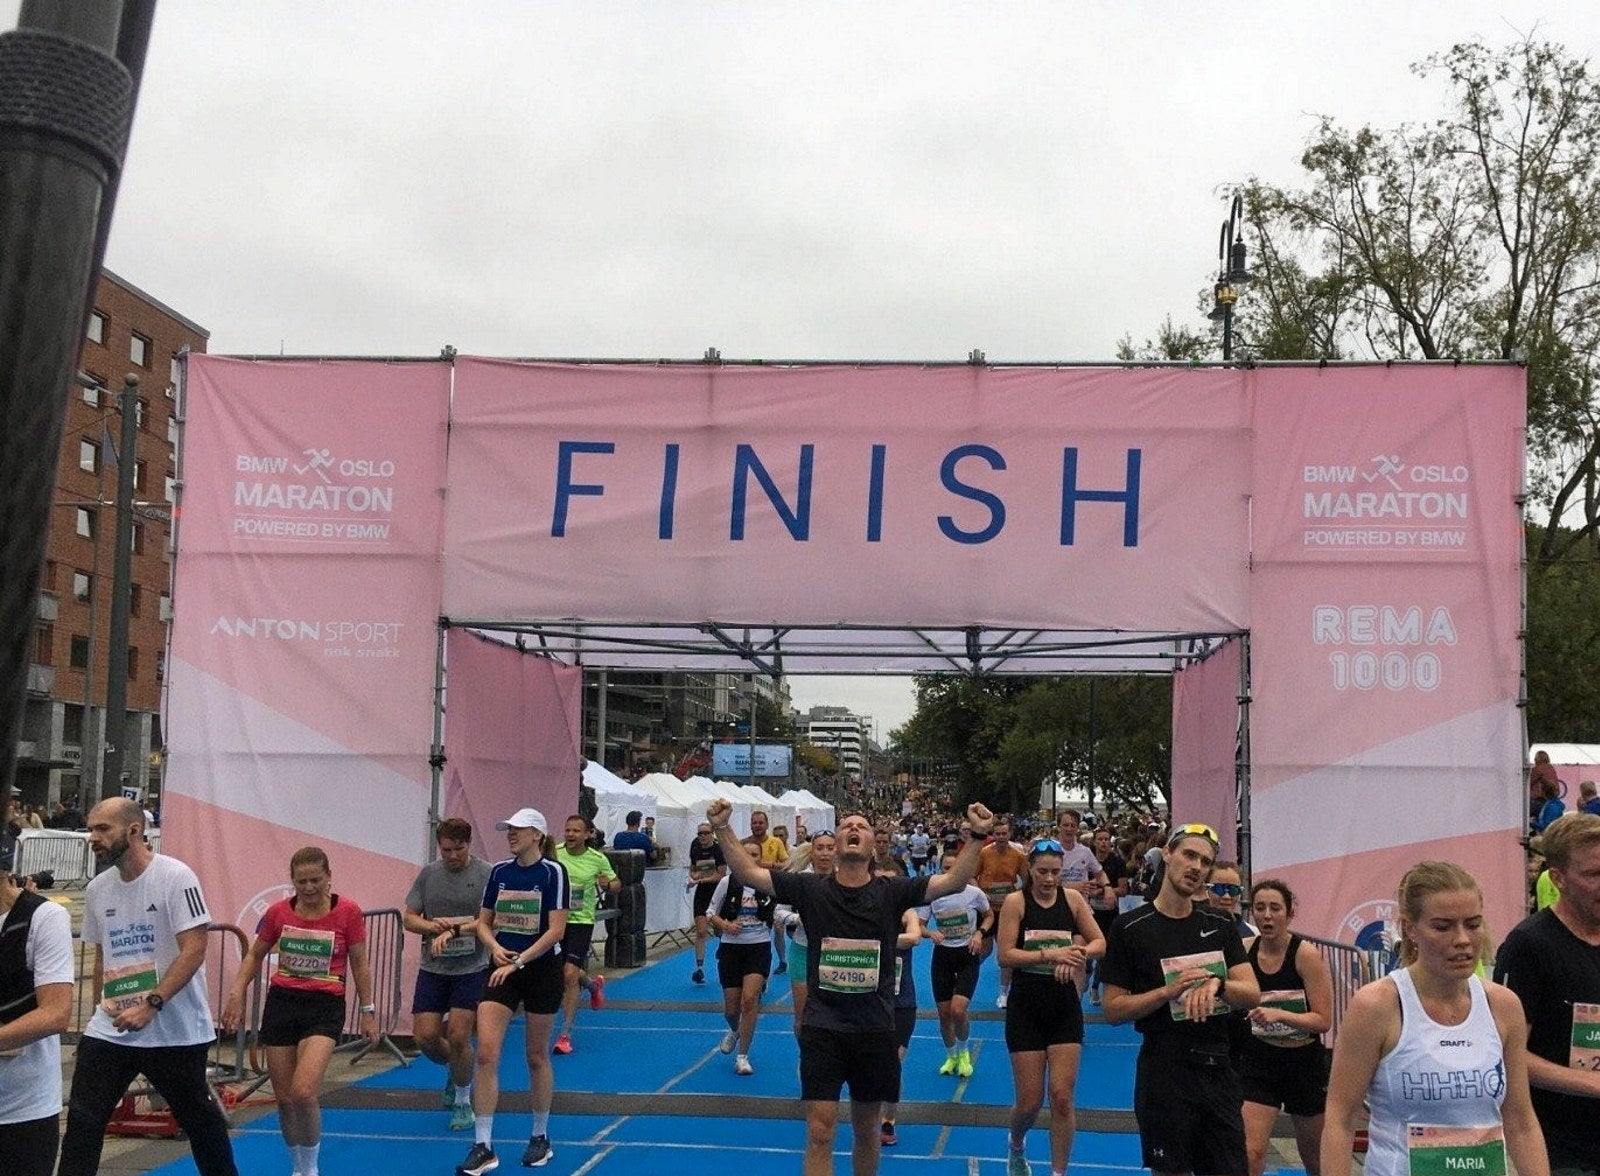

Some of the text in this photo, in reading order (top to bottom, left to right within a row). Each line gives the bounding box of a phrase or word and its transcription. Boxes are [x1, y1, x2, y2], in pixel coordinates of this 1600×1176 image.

[235, 455, 395, 477] BMW OSLO
[1303, 465, 1469, 483] BMW OSLO
[234, 481, 393, 512] MARATON
[551, 441, 1141, 547] FINISH
[1303, 492, 1468, 518] MARATON
[234, 518, 389, 539] POWERED BY BMW
[1303, 530, 1466, 546] POWERED BY BMW
[210, 615, 405, 643] ANTON SPORT
[1312, 604, 1458, 645] REMA
[1329, 650, 1442, 691] 1000
[286, 942, 305, 950] ANNE
[826, 954, 875, 964] CHRISTOPHER
[831, 971, 866, 983] 24190
[1445, 1157, 1486, 1170] MARIA
